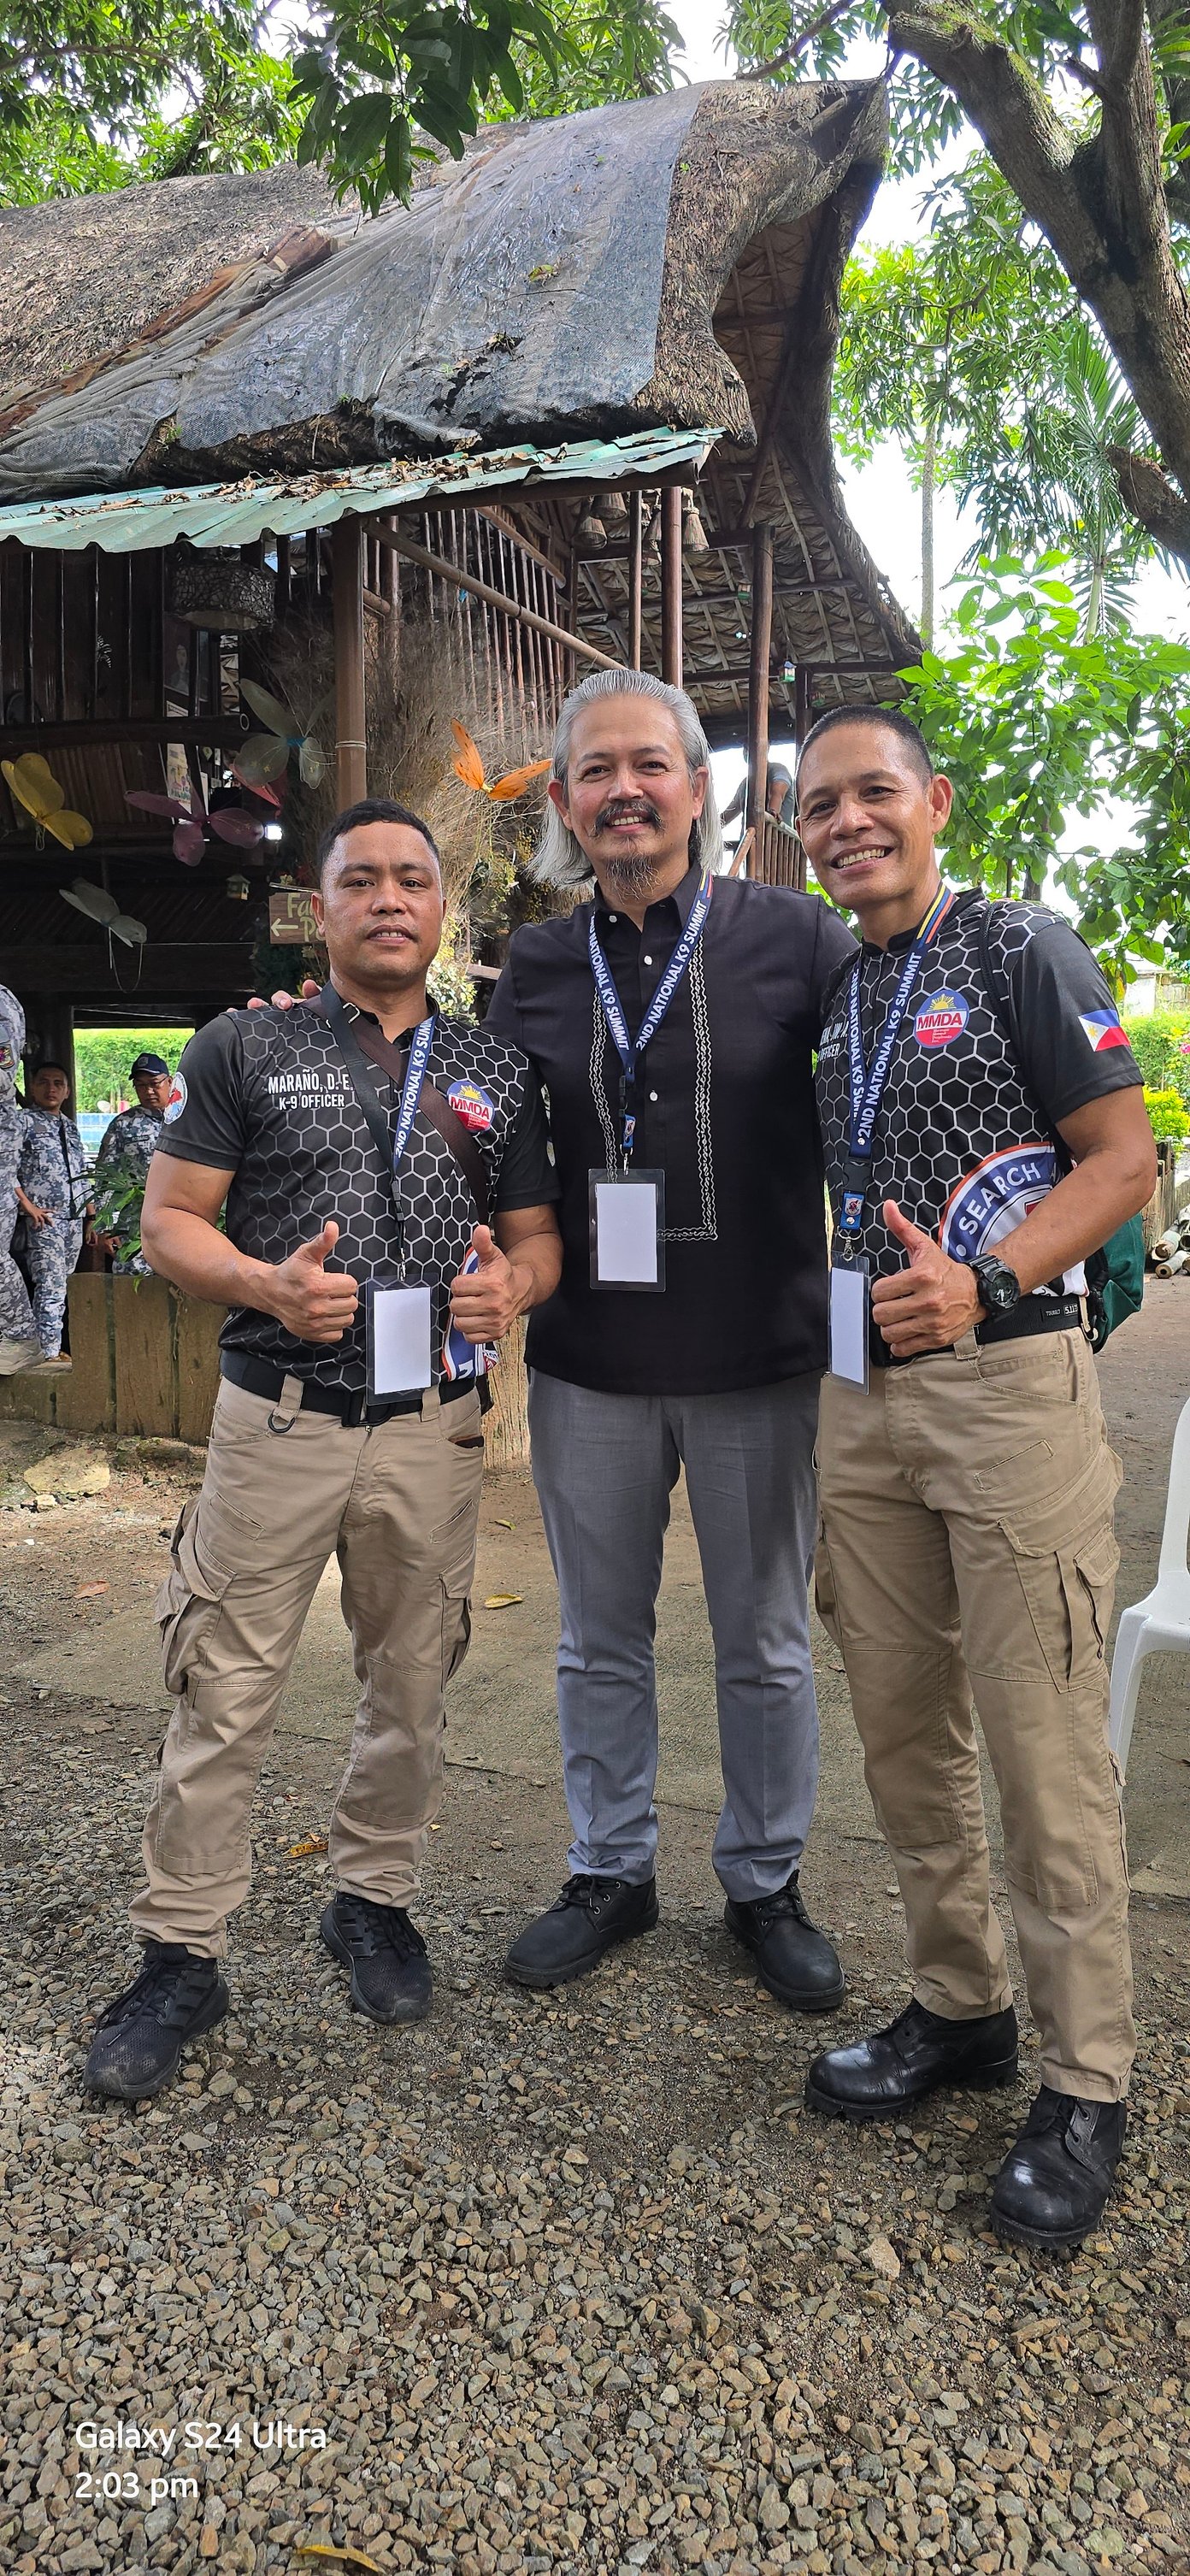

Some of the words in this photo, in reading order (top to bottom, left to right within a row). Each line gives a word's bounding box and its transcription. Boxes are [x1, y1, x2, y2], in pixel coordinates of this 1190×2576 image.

[589, 932, 609, 988] NATIONAL
[636, 1027, 654, 1051] 2ND
[649, 963, 683, 1024] NATIONAL
[676, 944, 691, 963] K9
[684, 900, 707, 945] SUMMIT
[601, 987, 616, 1005] K9
[895, 952, 922, 1007] SUMMIT
[606, 1006, 630, 1051] SUMMIT
[850, 996, 862, 1065] NATIONAL
[887, 1010, 901, 1030] K9
[917, 1012, 963, 1029] MMDA
[268, 1069, 324, 1093] MARAÑO,
[851, 1064, 863, 1085] K9
[865, 1033, 895, 1105] NATIONAL
[279, 1095, 298, 1111] K-9
[301, 1094, 345, 1108] OFFICER
[395, 1132, 407, 1158] 2ND
[401, 1070, 422, 1130] NATIONAL
[414, 1049, 427, 1068] K9
[451, 1096, 490, 1120] MMDA
[858, 1108, 875, 1139] 2ND
[958, 1162, 1041, 1235] SEARCH
